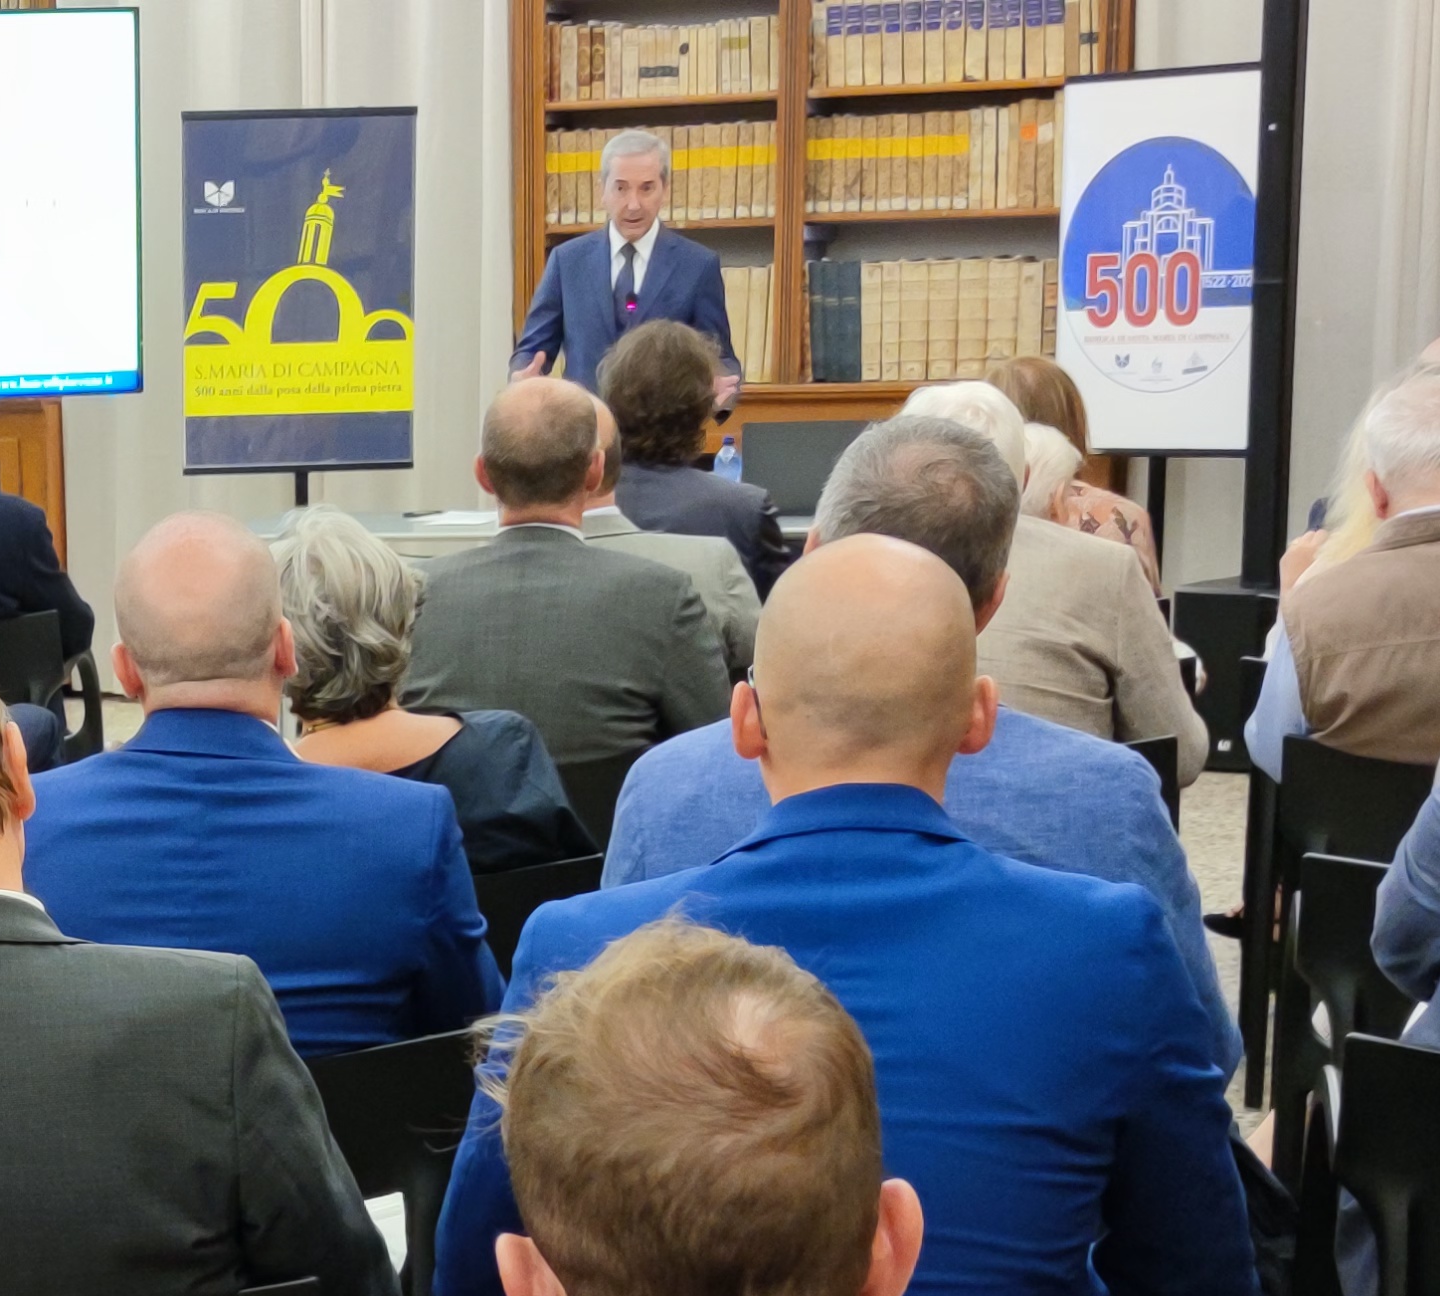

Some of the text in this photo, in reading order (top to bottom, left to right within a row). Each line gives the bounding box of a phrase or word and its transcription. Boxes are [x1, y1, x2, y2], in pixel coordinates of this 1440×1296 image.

[1086, 251, 1201, 329] 500
[273, 362, 292, 378] DI
[297, 359, 400, 378] CAMPAGNA
[218, 386, 243, 397] anni
[246, 384, 272, 396] dalla
[276, 386, 301, 398] posa
[304, 383, 331, 395] della
[334, 383, 367, 397] prima
[370, 382, 403, 397] pietra
